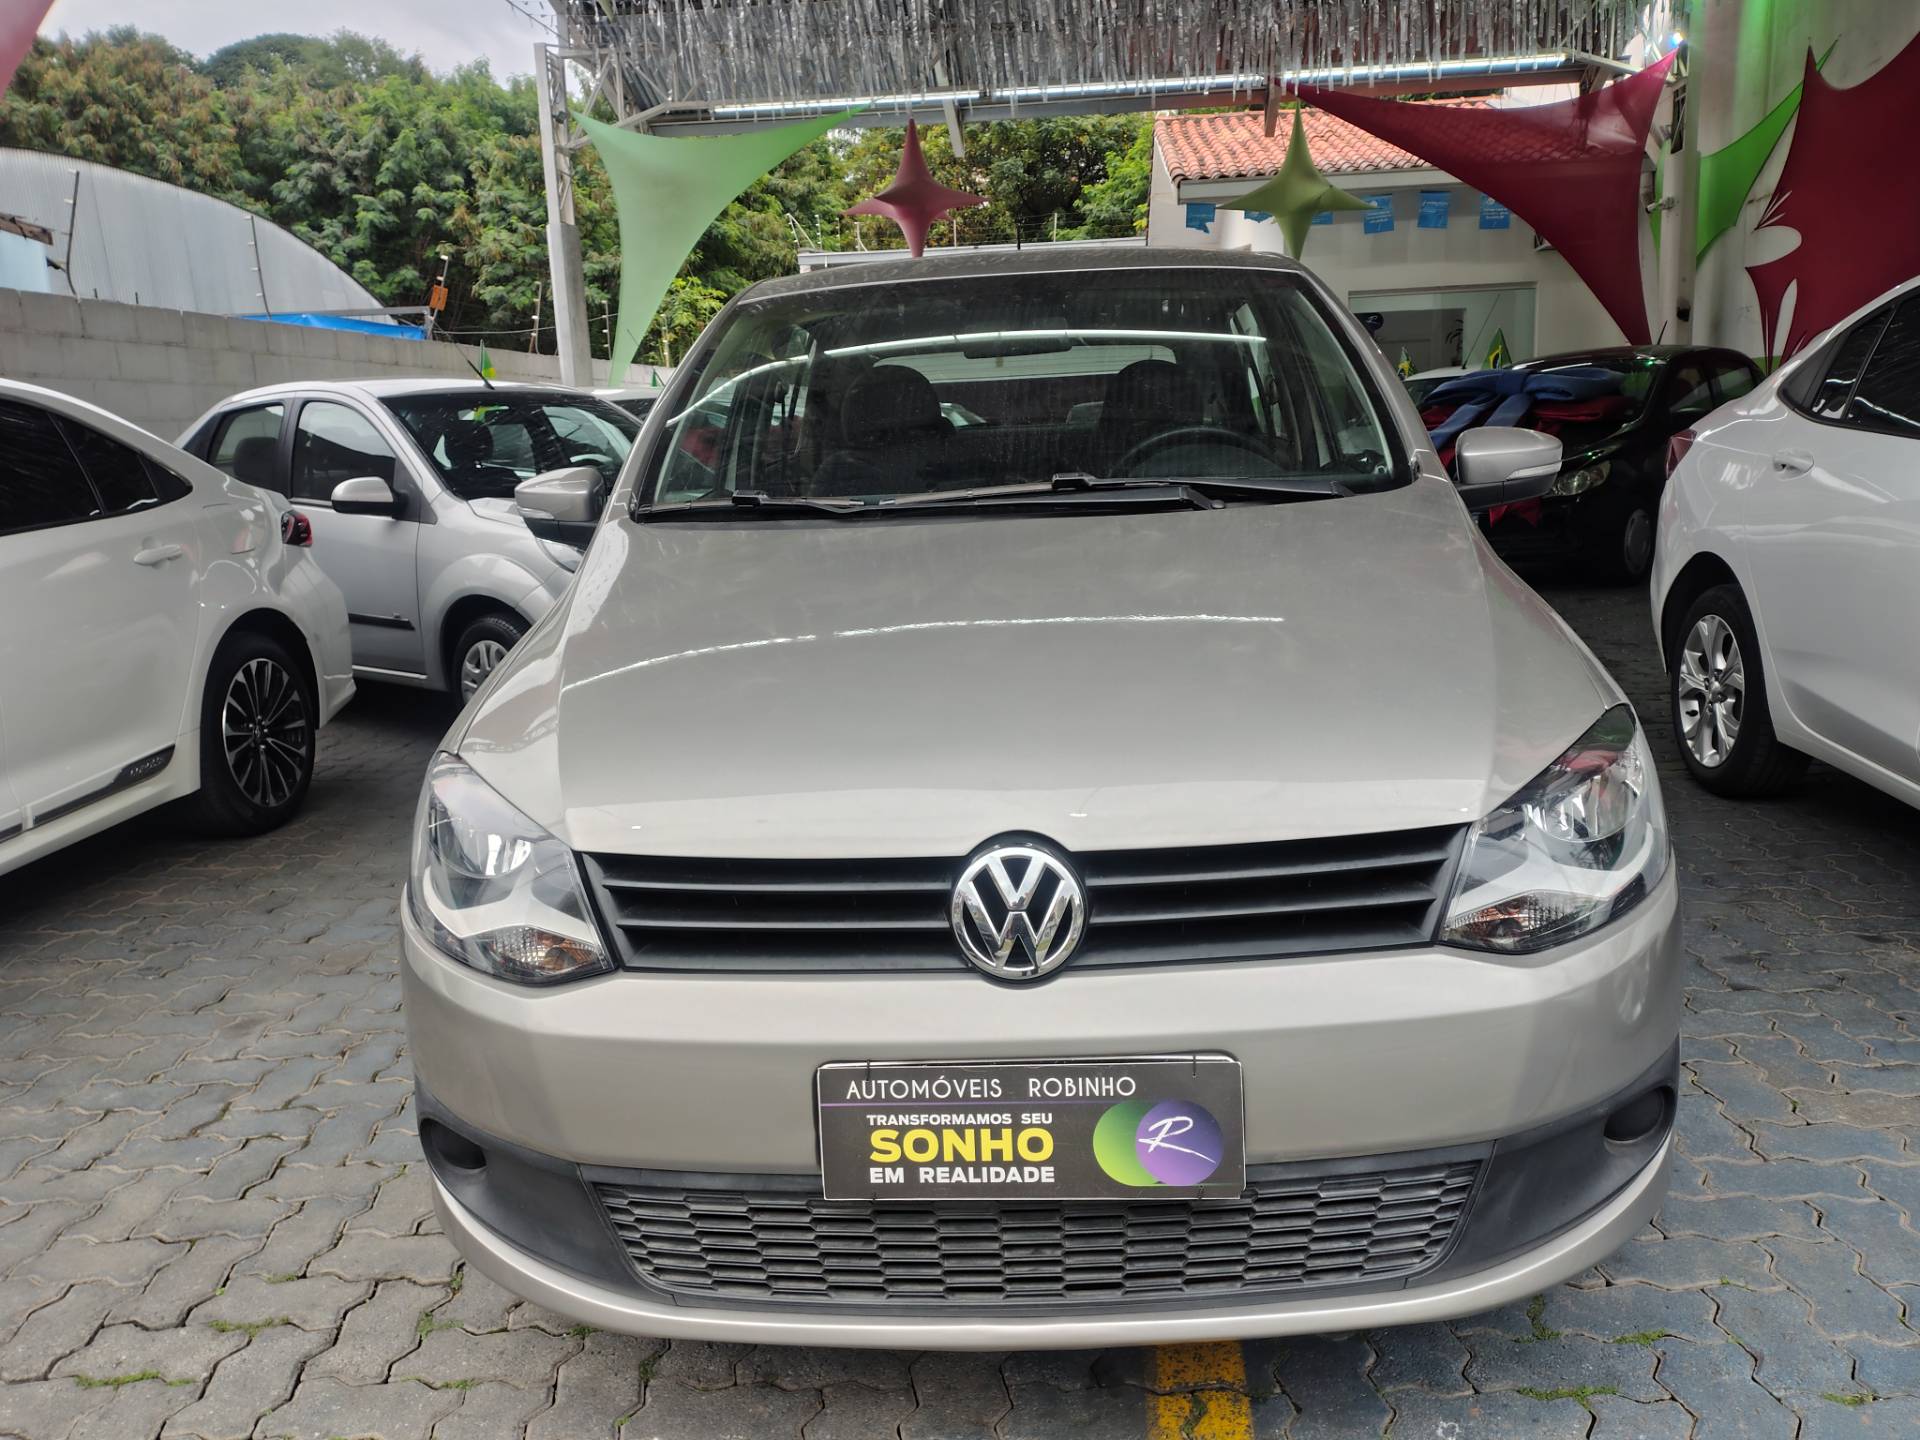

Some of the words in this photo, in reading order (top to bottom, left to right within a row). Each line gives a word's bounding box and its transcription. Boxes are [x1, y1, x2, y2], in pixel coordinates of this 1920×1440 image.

[846, 1075, 1003, 1100] AUTOMÓVEIS
[1028, 1076, 1137, 1098] ROBINHO
[866, 1113, 1013, 1126] TRANSFORMAMOS
[1020, 1112, 1053, 1125] SEU
[869, 1127, 1055, 1163] SONHO
[869, 1167, 905, 1184] EM
[918, 1166, 1056, 1184] REALIDADE
